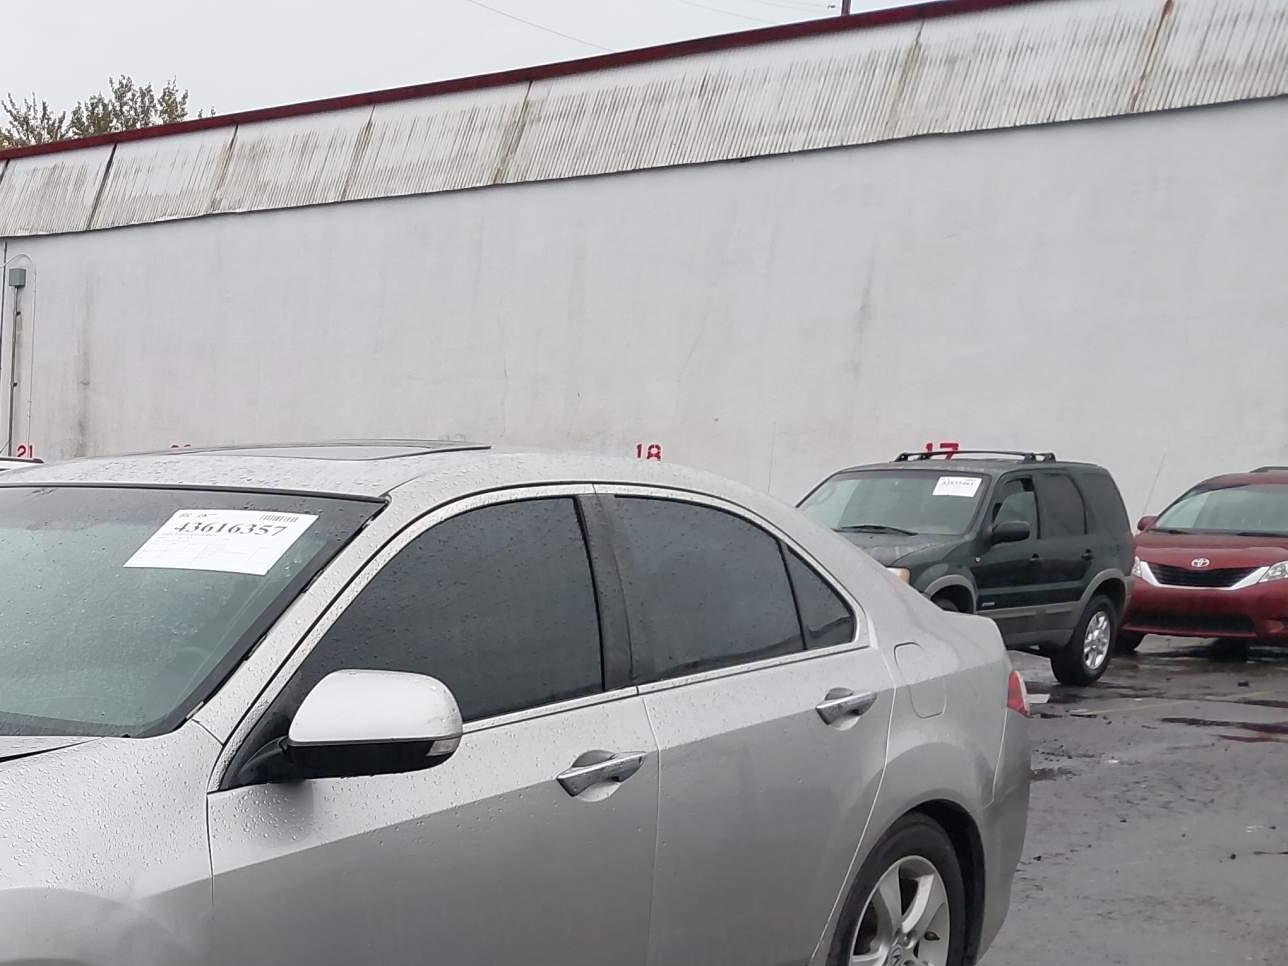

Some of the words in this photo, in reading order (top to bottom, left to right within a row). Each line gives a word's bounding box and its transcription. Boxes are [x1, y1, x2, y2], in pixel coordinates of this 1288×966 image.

[17, 444, 33, 459] 21
[636, 443, 662, 461] 18
[925, 442, 960, 462] 17
[174, 521, 288, 537] 43616357
